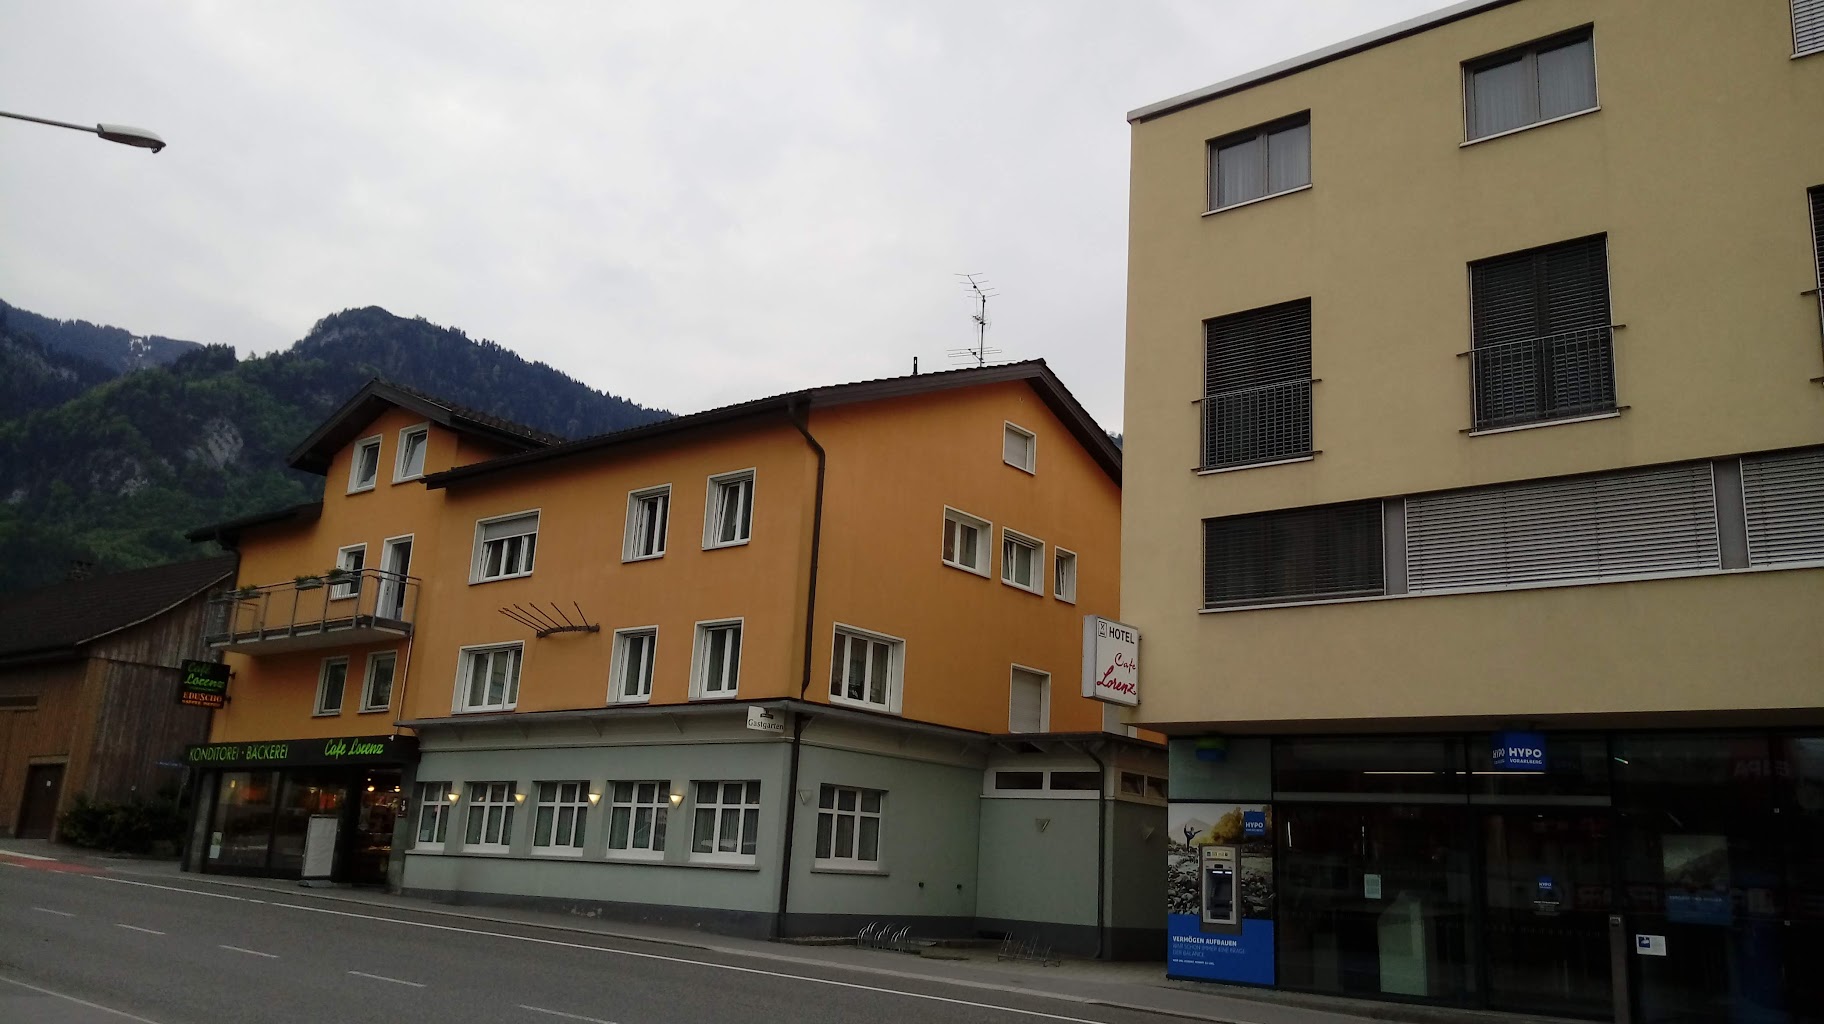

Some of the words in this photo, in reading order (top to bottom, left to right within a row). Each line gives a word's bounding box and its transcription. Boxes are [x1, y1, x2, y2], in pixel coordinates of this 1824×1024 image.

[1109, 626, 1135, 644] HOTEL
[1114, 652, 1136, 673] Cafe
[184, 673, 225, 688] Lorenz
[1096, 665, 1136, 695] Lorenz
[183, 691, 222, 703] EDUSCHO
[748, 718, 784, 730] Gastgarten
[188, 746, 239, 762] KONDITOREI
[324, 739, 347, 759] Cafe
[347, 738, 385, 756] Lorenz
[1508, 747, 1542, 758] HYPO
[1172, 935, 1205, 943] VERMÖGEN
[1205, 938, 1237, 947] AUFBAUEN
